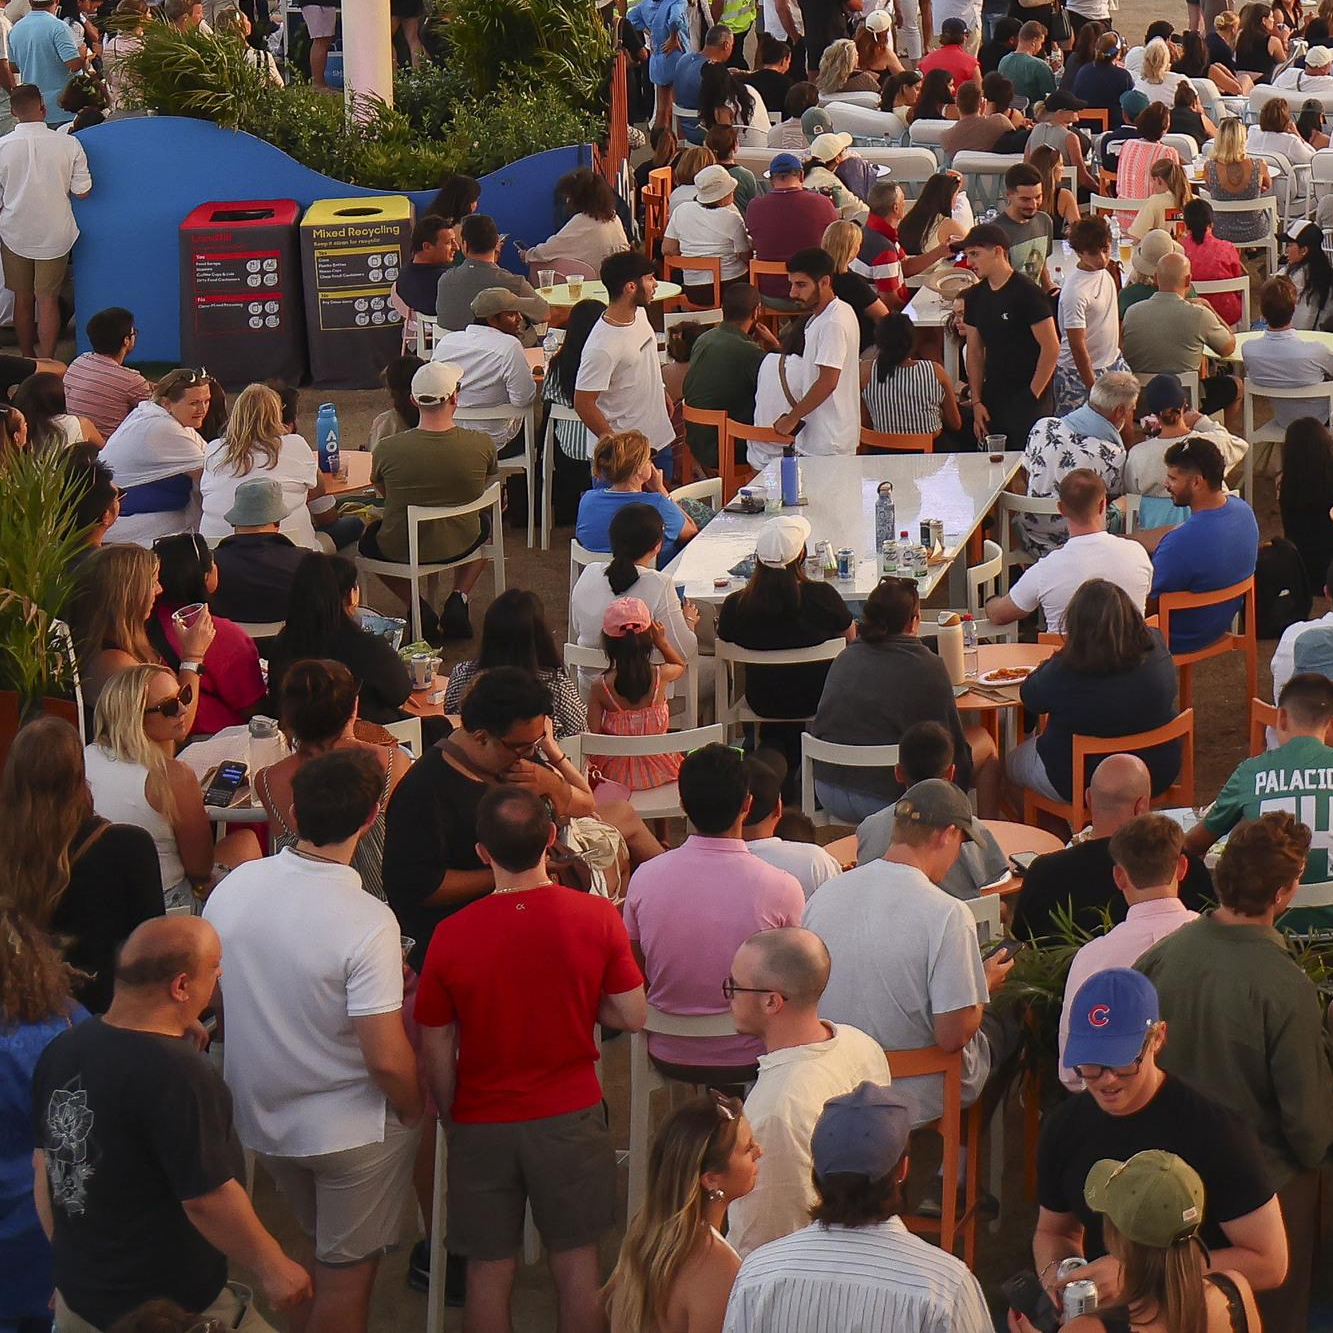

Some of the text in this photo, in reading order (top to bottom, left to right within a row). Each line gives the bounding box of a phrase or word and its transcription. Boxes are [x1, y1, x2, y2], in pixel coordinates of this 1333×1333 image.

[313, 225, 400, 239] Mixed Recycling
[1088, 1004, 1111, 1027] C
